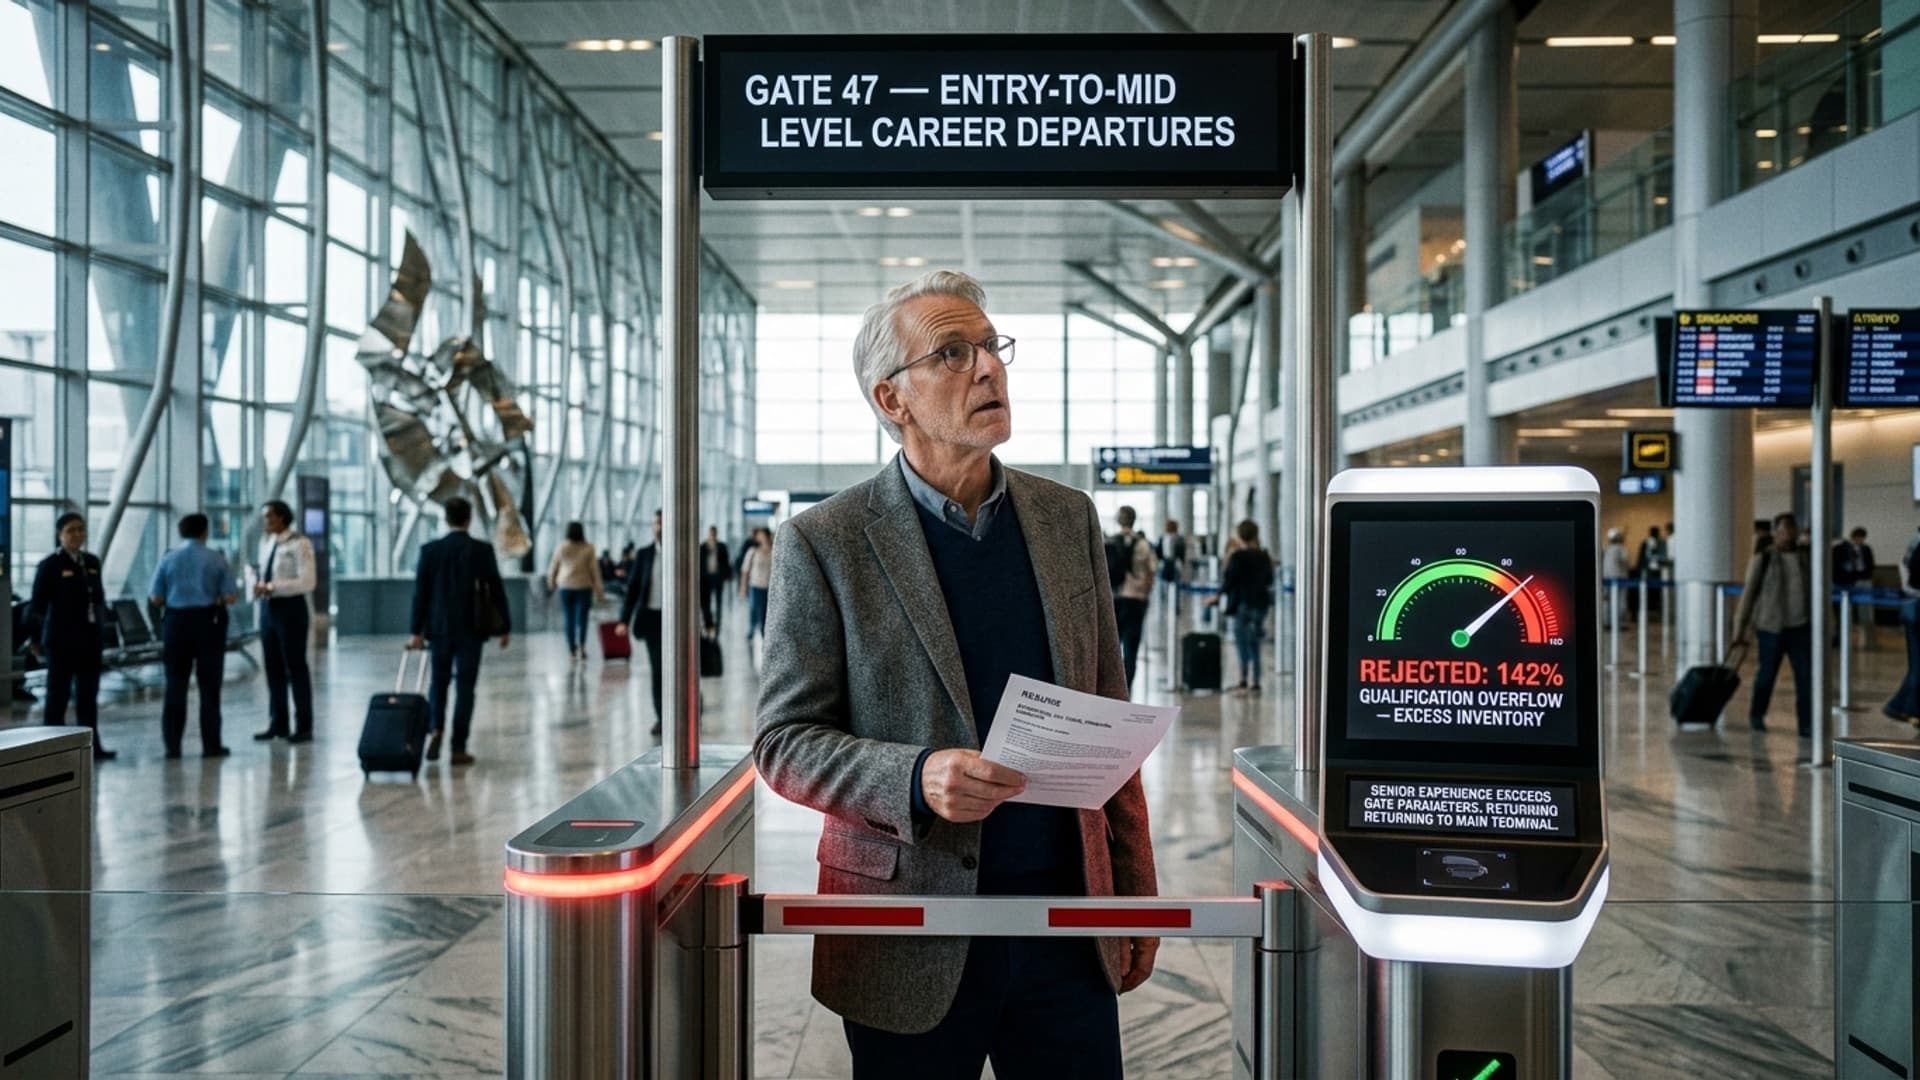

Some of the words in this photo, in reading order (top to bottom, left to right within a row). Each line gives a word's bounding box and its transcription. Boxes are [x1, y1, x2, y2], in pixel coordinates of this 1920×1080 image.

[745, 74, 832, 106] GATE
[841, 74, 879, 106] 47
[940, 73, 1176, 105] ENTRY-TO-MID
[761, 117, 863, 148] LEVEL
[871, 116, 1007, 148] CAREER
[1017, 116, 1236, 147] DEPARTURES
[1360, 659, 1489, 685] REJECTED:
[1497, 662, 1564, 687] 142%
[1478, 690, 1564, 708] OVERFLOW
[1457, 709, 1545, 727] INVENTORY
[1371, 784, 1415, 797] SENIOR
[1364, 797, 1395, 810] GATE
[1364, 810, 1434, 825] RETURNING
[1437, 814, 1453, 826] TO
[1456, 814, 1488, 828] MAIN
